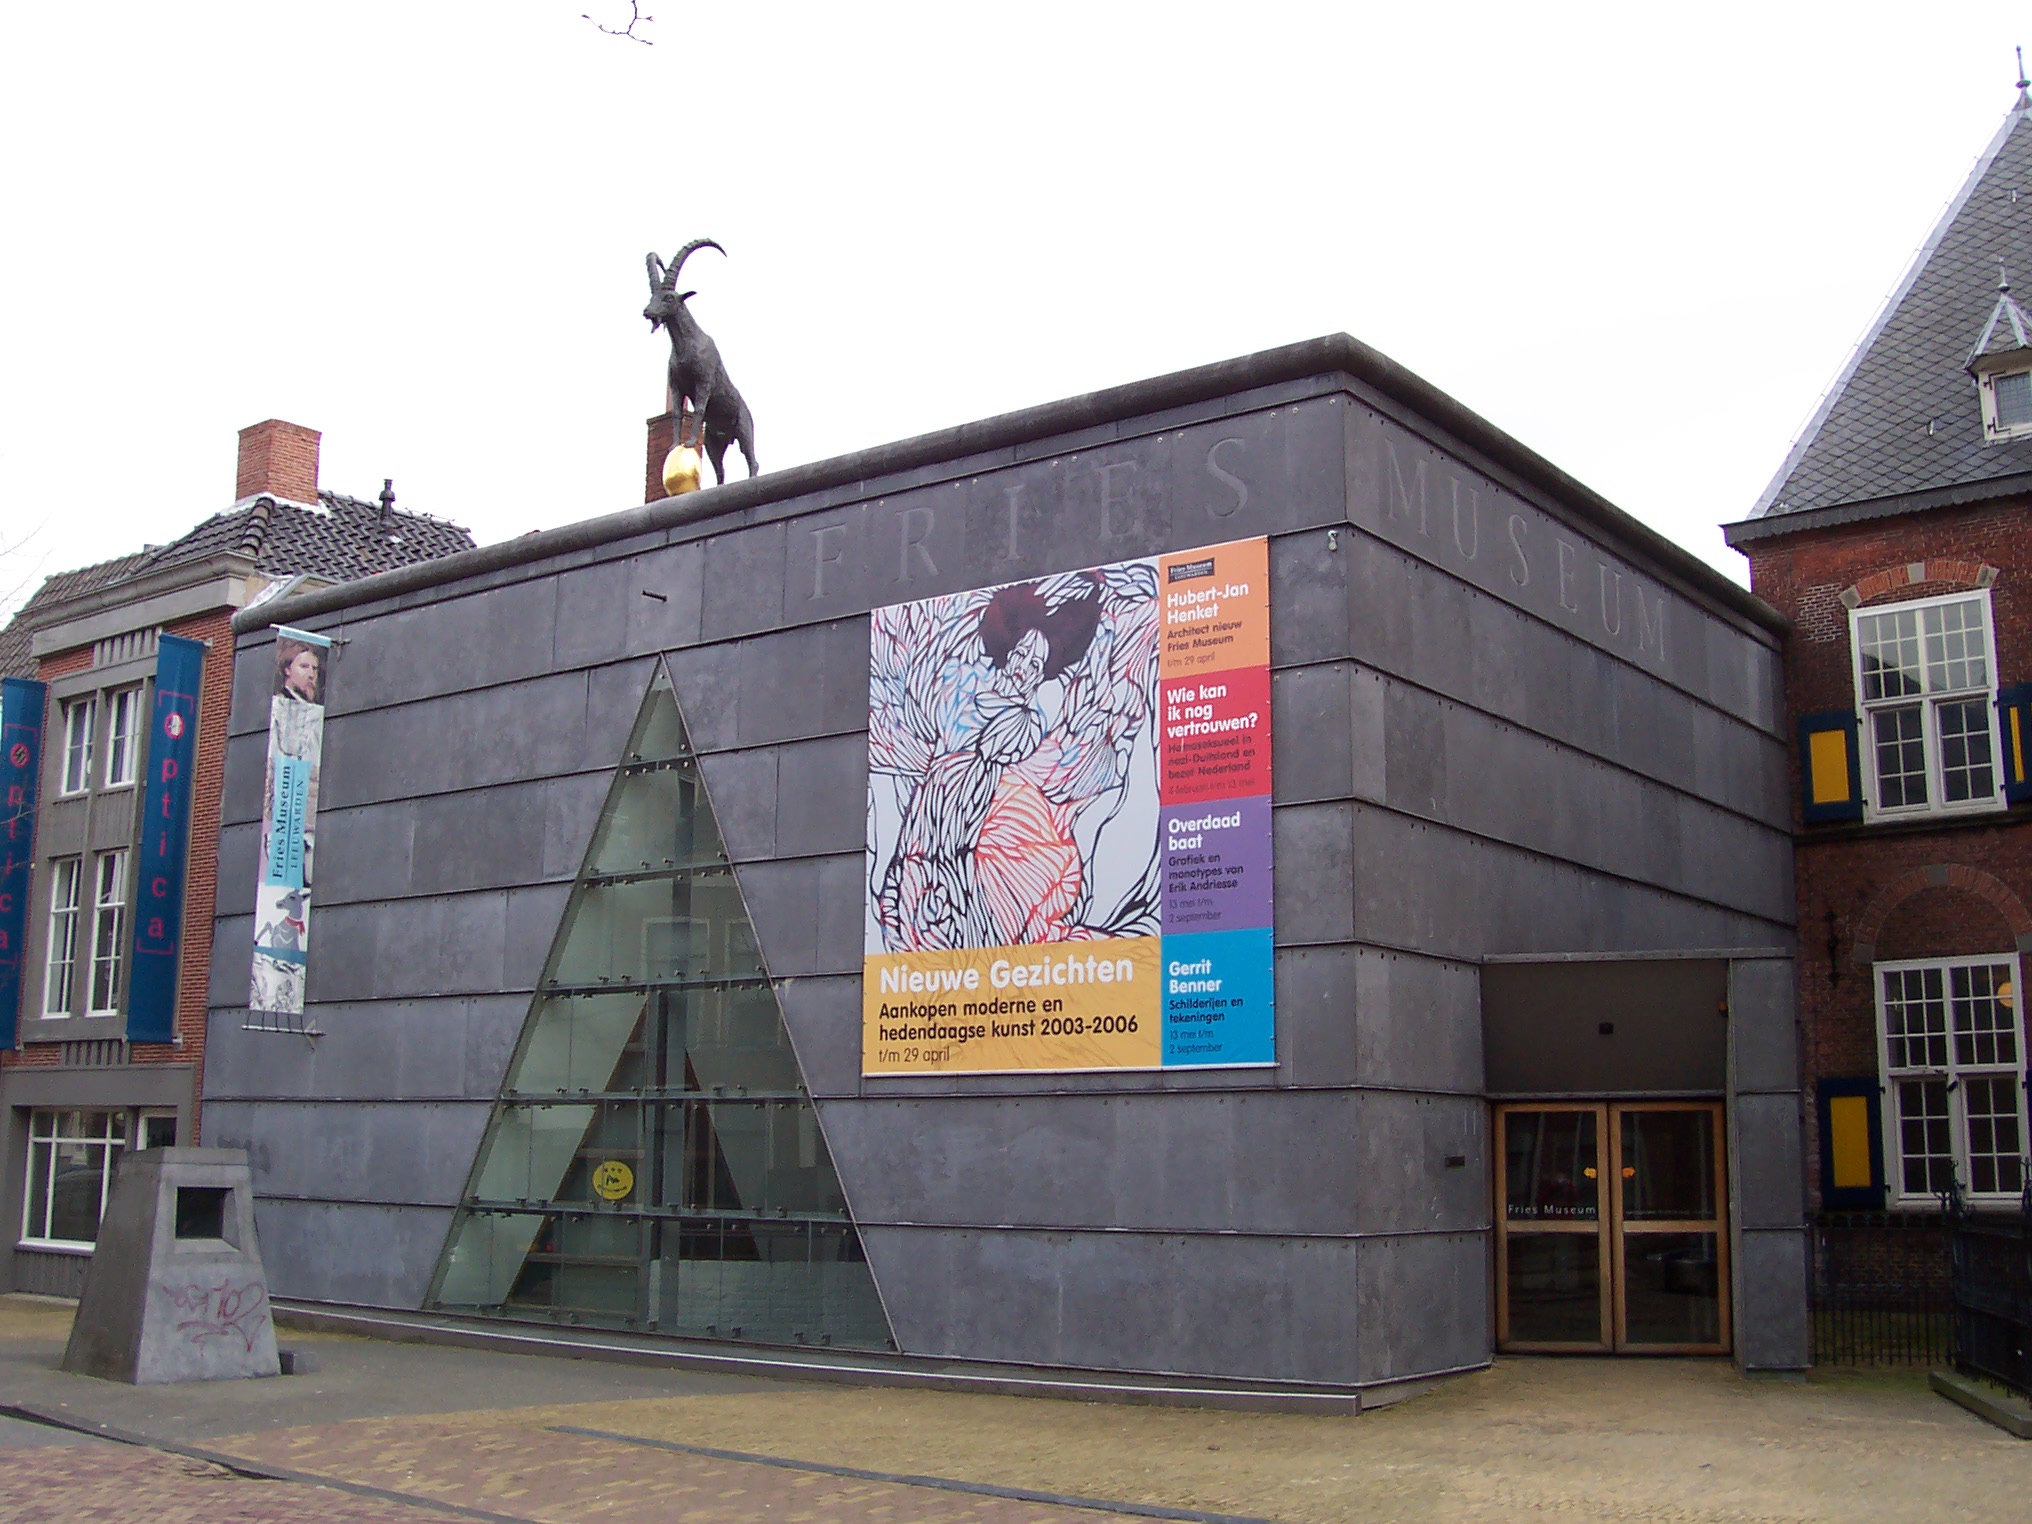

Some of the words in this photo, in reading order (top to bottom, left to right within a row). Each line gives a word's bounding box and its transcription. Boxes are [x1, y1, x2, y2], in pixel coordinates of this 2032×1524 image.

[808, 437, 1248, 600] FRIES
[1385, 437, 1666, 662] MUSEUM
[1167, 583, 1249, 608] Hubert-Jan
[1167, 603, 1219, 625] Henket
[1167, 624, 1210, 640] Architect
[1212, 620, 1243, 635] nieuw
[1167, 641, 1189, 653] Fries
[1192, 635, 1234, 648] Museum
[1167, 687, 1196, 705] Wie
[1199, 684, 1227, 700] kan
[1167, 705, 1181, 721] ik
[1185, 704, 1213, 720] nog
[1167, 712, 1258, 738] vertrouwen?
[275, 765, 291, 836] Museum
[291, 780, 304, 869] LEEUWARDEN
[1168, 811, 1240, 834] Overdaad
[1168, 834, 1203, 851] baat
[272, 841, 284, 879] Fries
[1168, 854, 1206, 867] Grafiek
[1208, 854, 1221, 863] en
[1225, 865, 1244, 875] van
[1168, 883, 1187, 894] Erik
[1190, 879, 1239, 891] Andriesse
[1176, 910, 1222, 925] september
[880, 963, 980, 995] Nieuwe
[990, 954, 1134, 989] Gezichten
[1168, 958, 1212, 976] Gerrit
[1169, 978, 1223, 994] Benner
[878, 1001, 957, 1022] Aankopen
[963, 997, 1036, 1016] moderne
[1042, 999, 1063, 1012] en
[1169, 997, 1227, 1011] Schilderijen
[1230, 998, 1244, 1007] en
[1169, 1011, 1225, 1025] tekeningen
[879, 1022, 986, 1044] hedendaagse
[991, 1018, 1036, 1038] kunst
[1040, 1015, 1139, 1036] 2003-2006
[878, 1049, 900, 1063] t/m
[903, 1047, 919, 1062] 29
[922, 1046, 950, 1065] april
[1176, 1042, 1223, 1056] september
[1507, 1204, 1538, 1215] Fries
[1543, 1204, 1597, 1215] Museum
